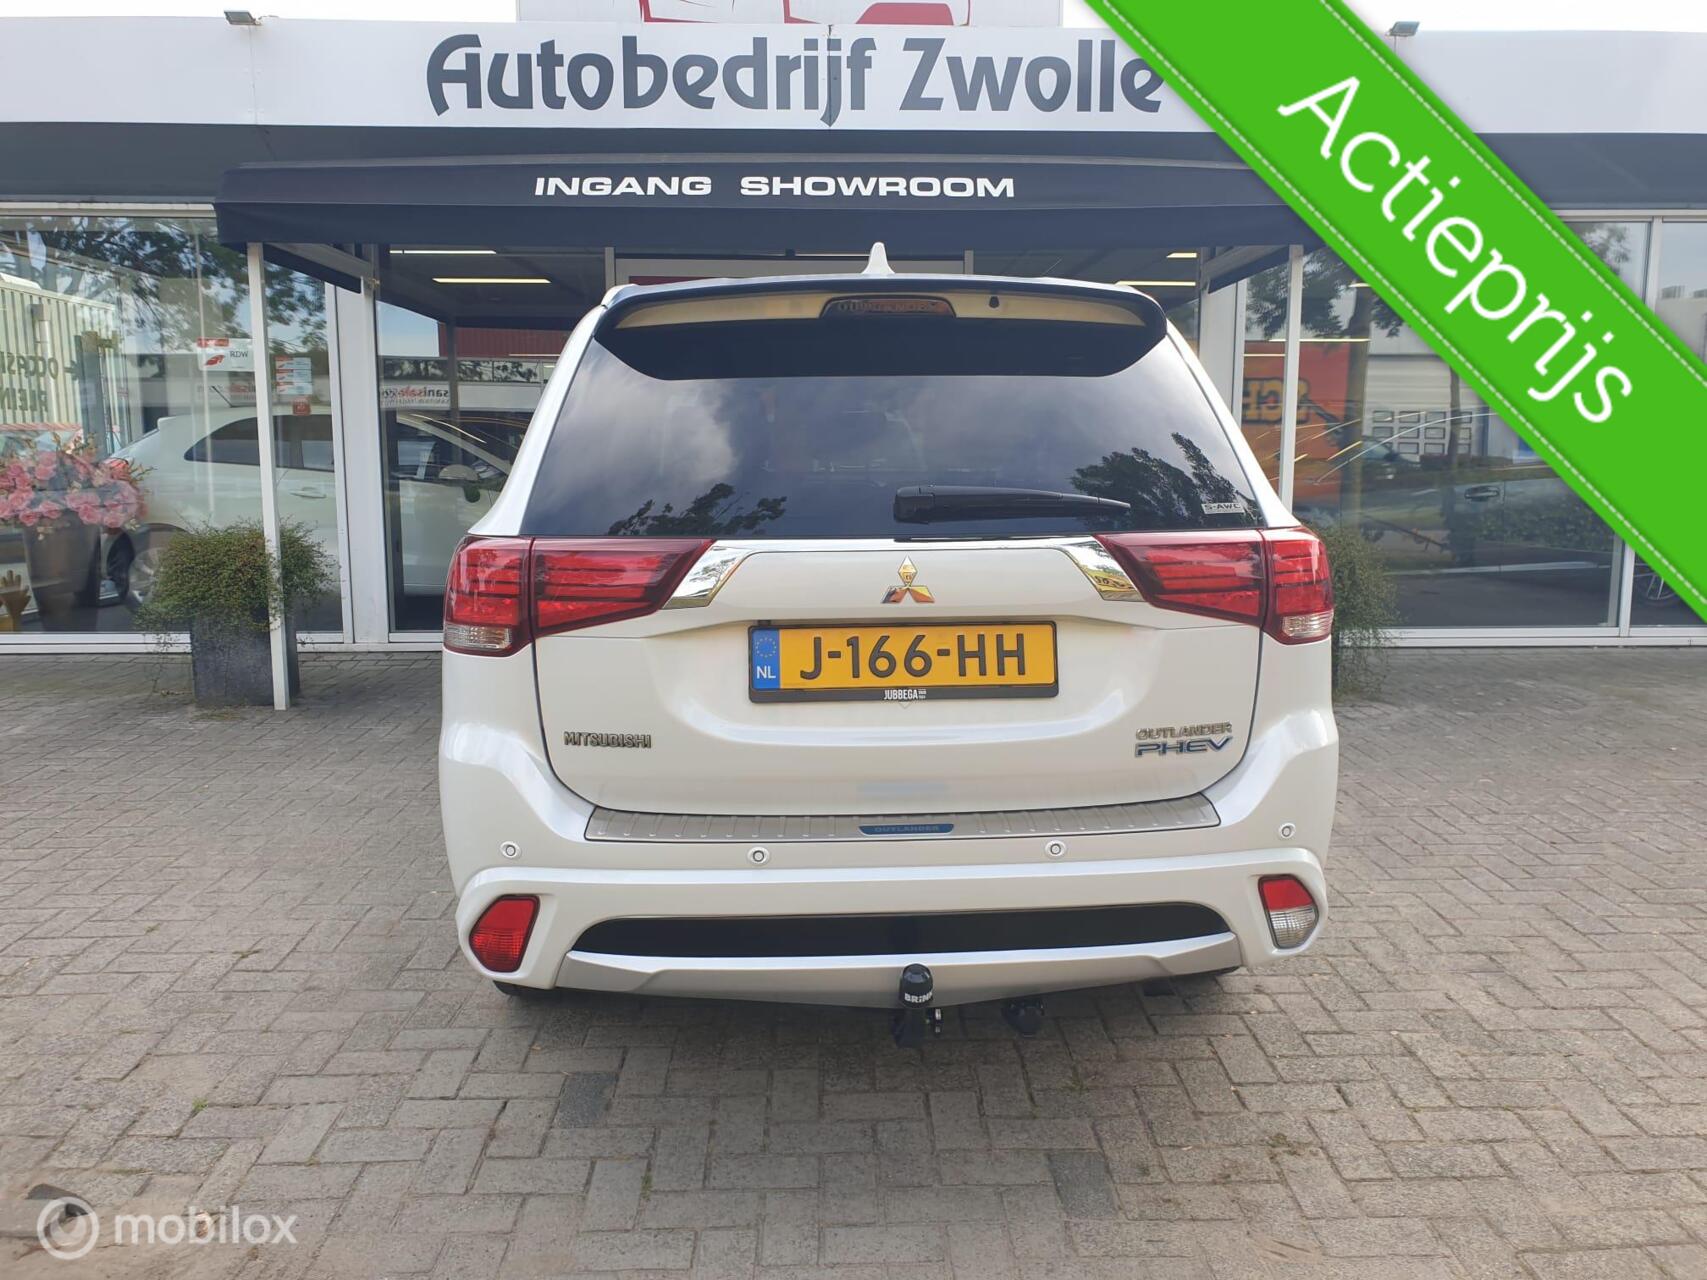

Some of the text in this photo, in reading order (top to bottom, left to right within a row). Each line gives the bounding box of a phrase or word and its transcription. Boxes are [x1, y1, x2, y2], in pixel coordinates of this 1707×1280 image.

[426, 34, 1165, 128] Autobedrijf Zwolle
[534, 176, 1015, 198] INGANG SHOWROOM
[229, 350, 249, 359] RDW
[800, 633, 1026, 680] J-166-HH
[756, 665, 776, 679] NL
[884, 689, 919, 700] JUBBEGA
[563, 731, 652, 749] MITSUBISHI
[1136, 722, 1232, 740] OUTLANDER
[1135, 736, 1234, 758] PHEV
